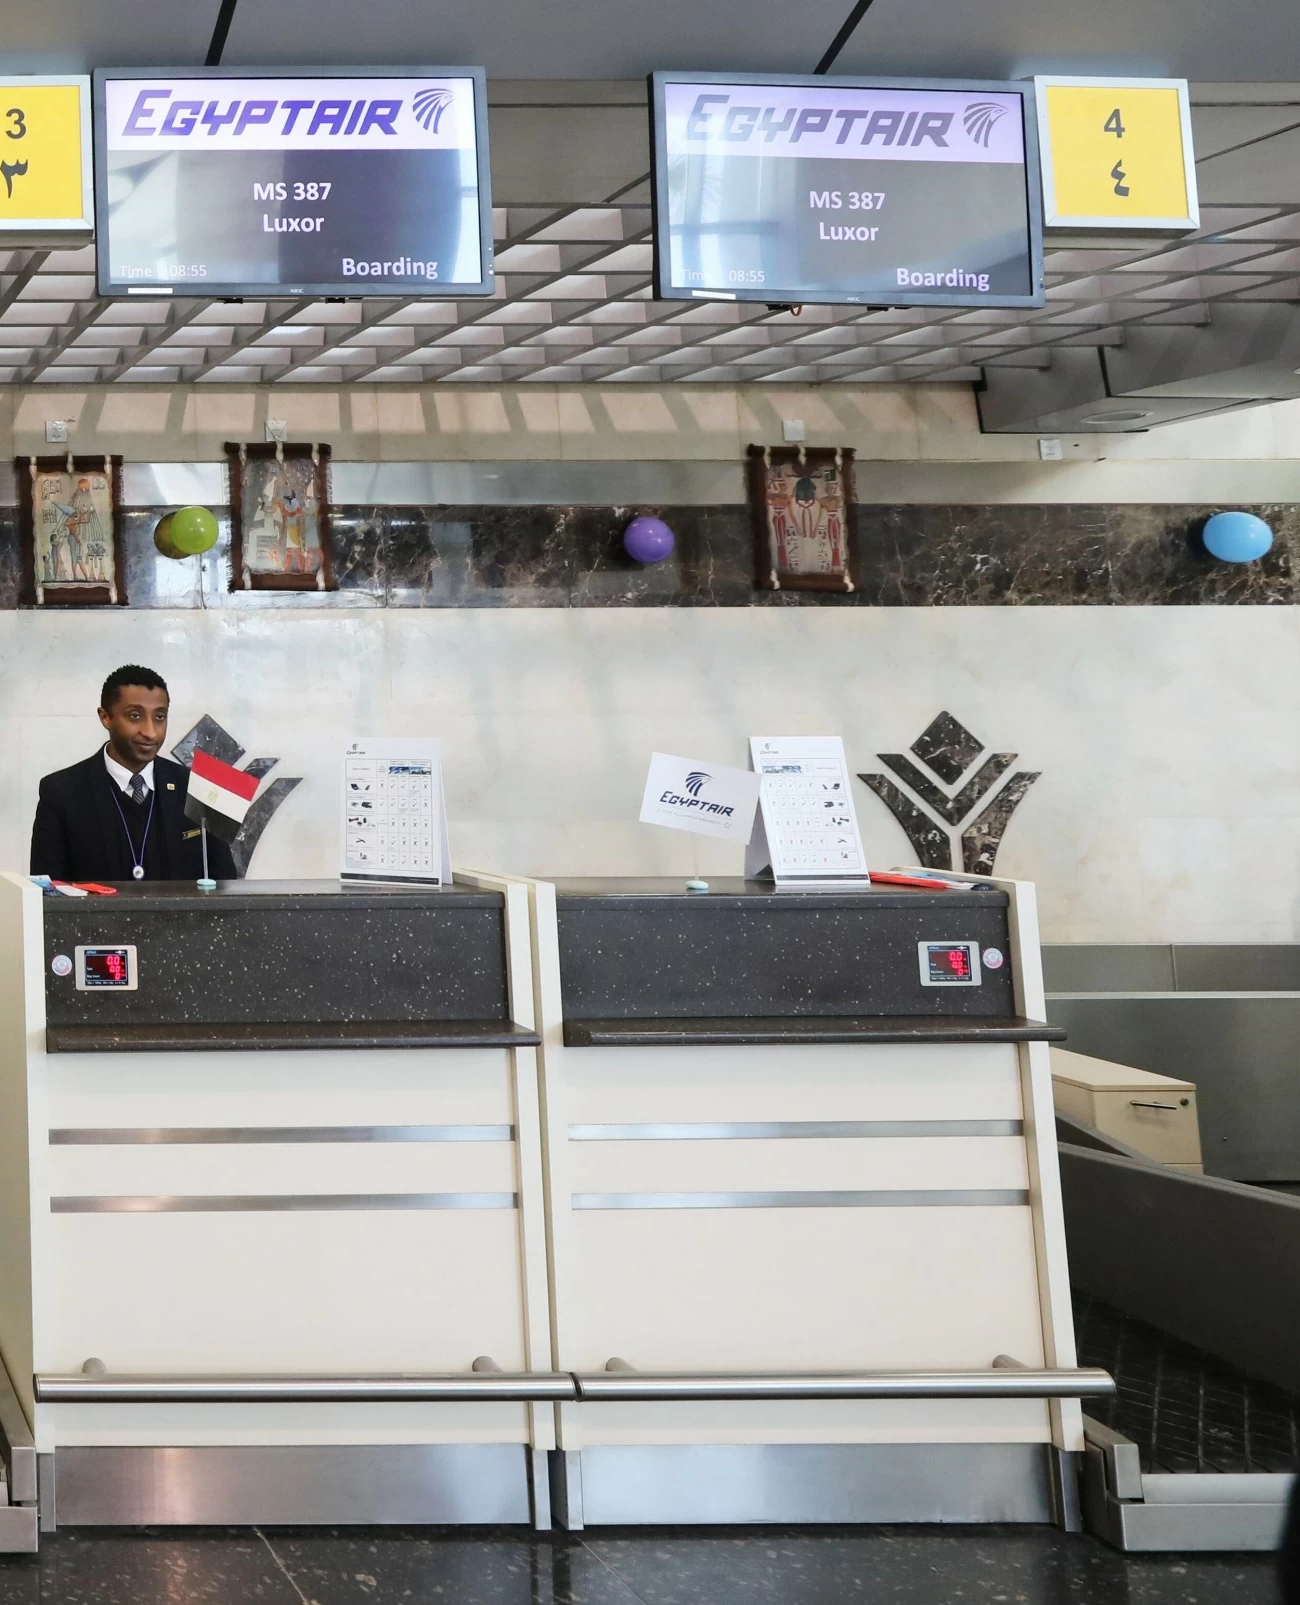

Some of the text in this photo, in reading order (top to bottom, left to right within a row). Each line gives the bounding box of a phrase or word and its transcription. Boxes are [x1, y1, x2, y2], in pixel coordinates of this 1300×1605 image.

[5, 108, 27, 140] 3
[122, 89, 403, 137] EGYPTAIR
[686, 94, 955, 149] EGYPTAIR
[1103, 108, 1126, 139] 4
[253, 182, 332, 201] MS 387
[809, 191, 886, 211] MS 387
[262, 214, 325, 233] Luxor
[819, 222, 879, 242] Luxor
[170, 264, 207, 277] 08:55
[341, 257, 438, 280] Boarding
[729, 270, 765, 283] 08:55
[896, 267, 991, 293] Boarding
[659, 790, 734, 817] EGYPTAIR
